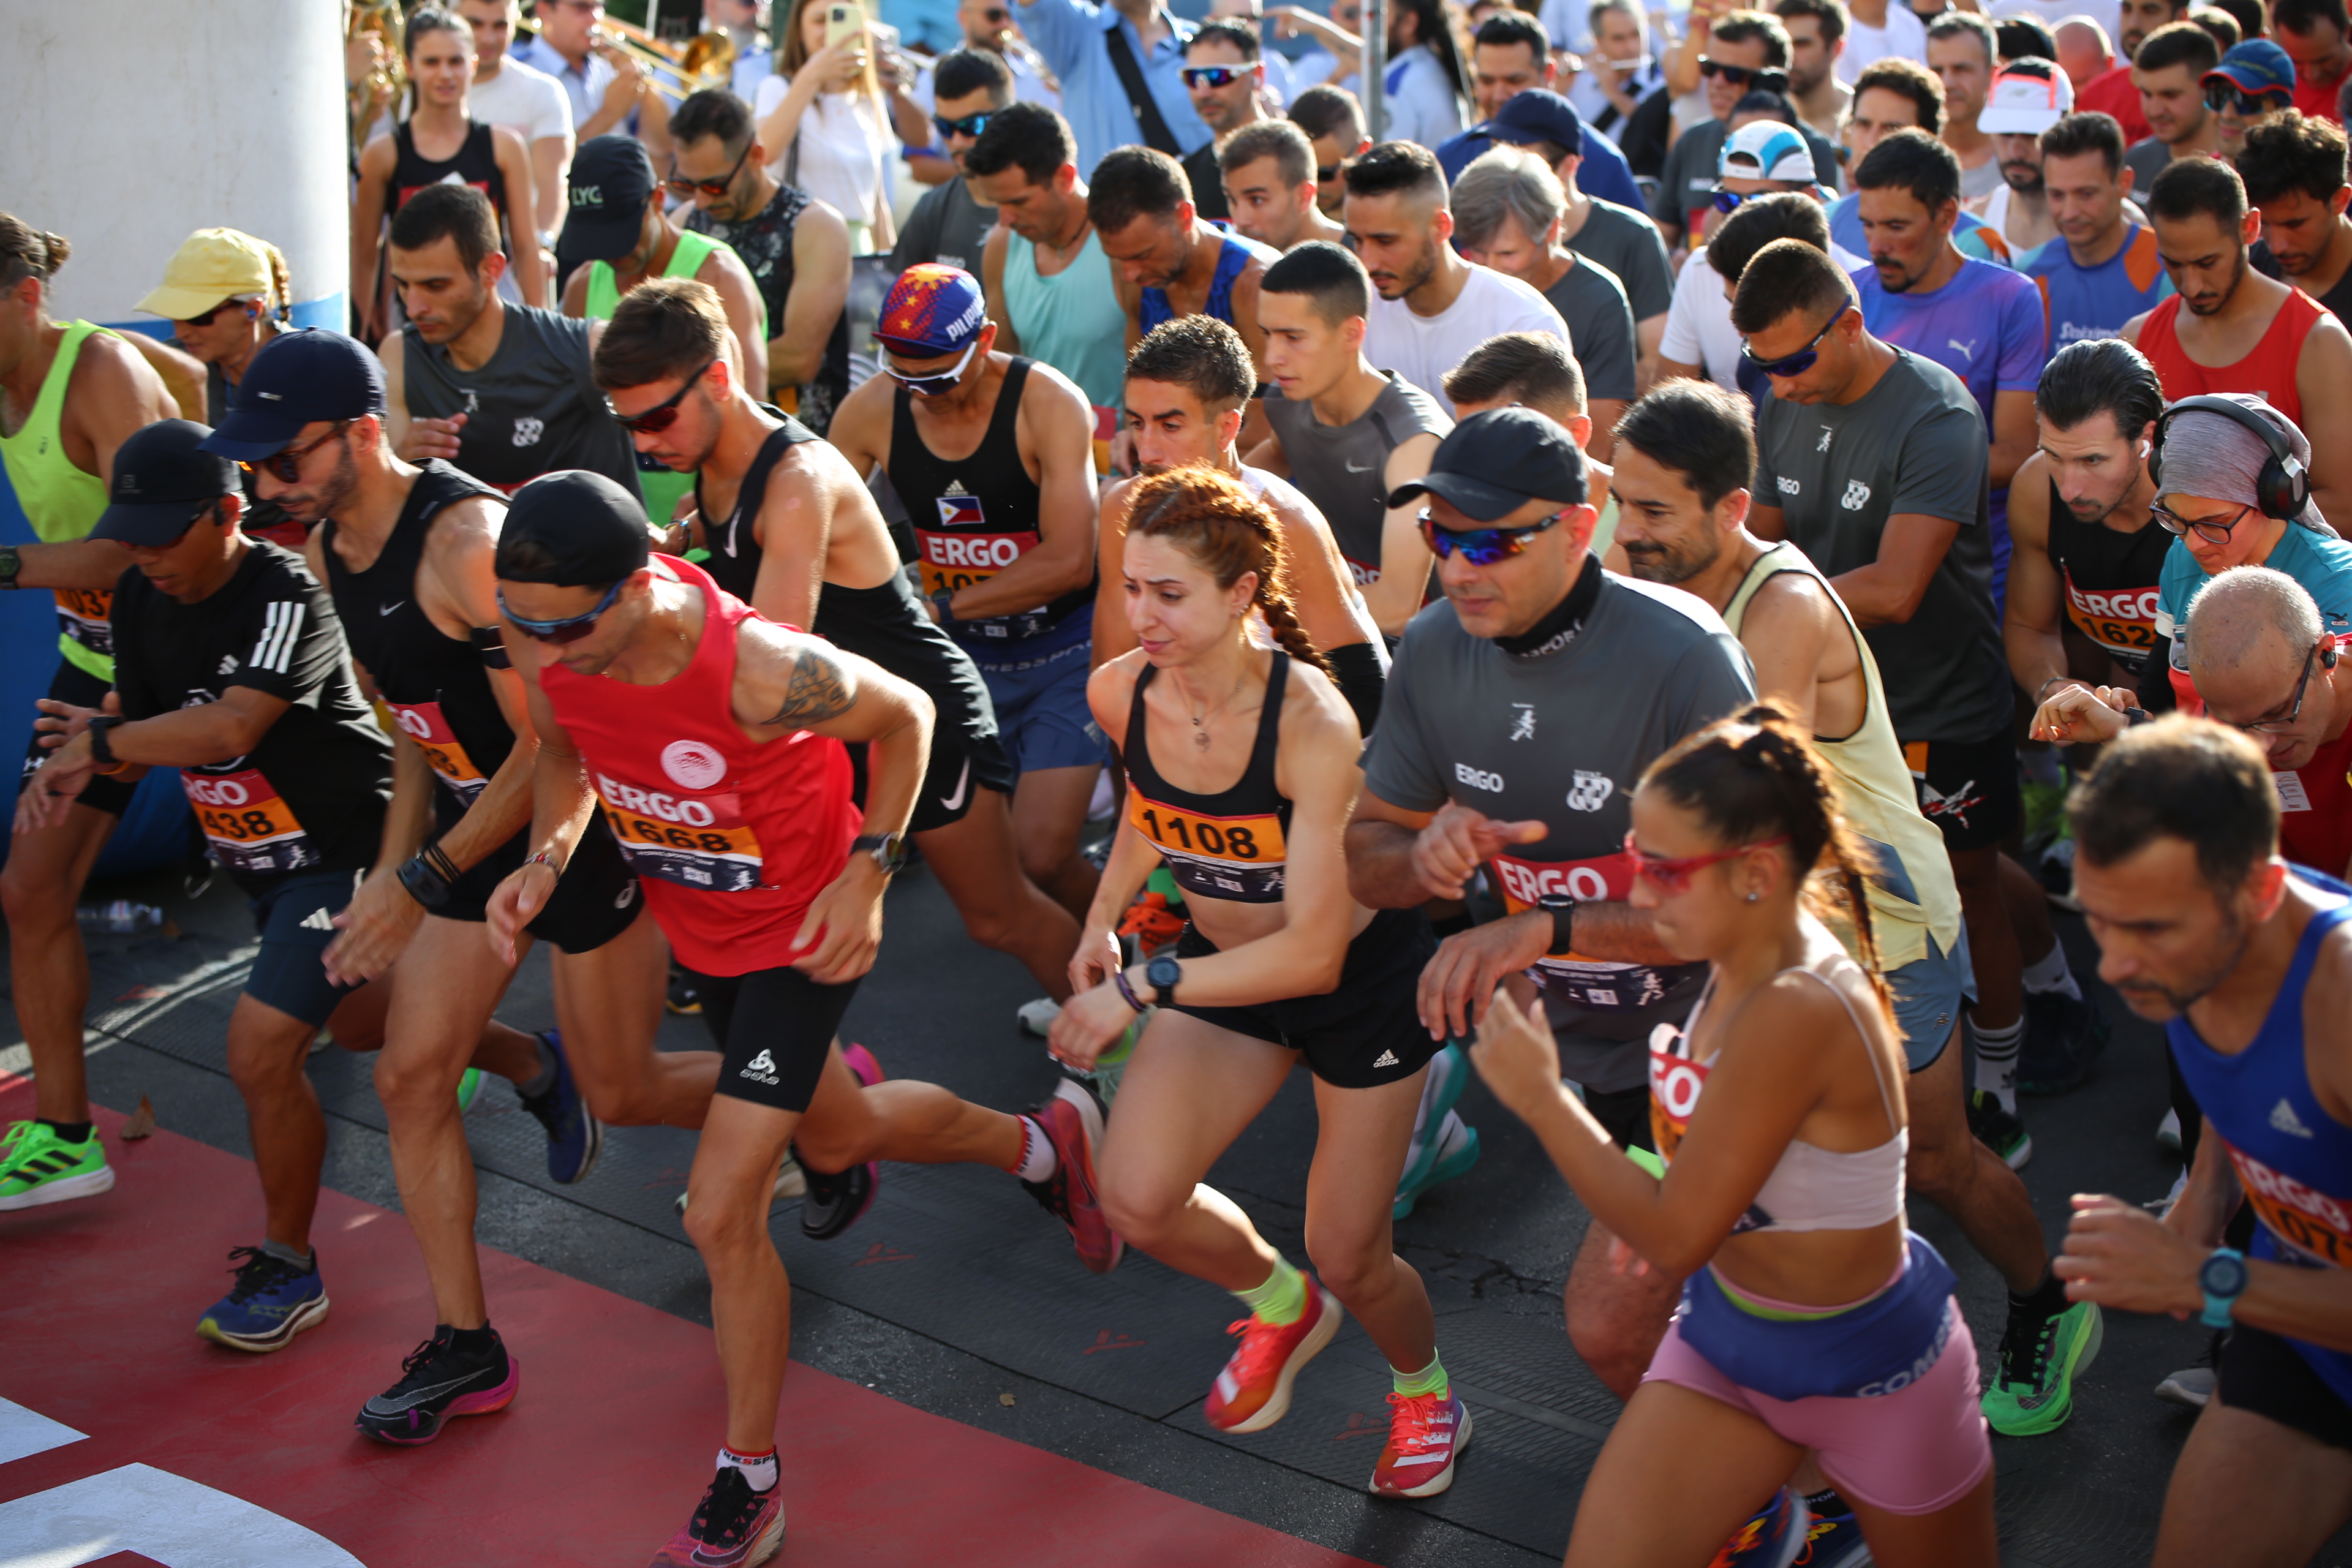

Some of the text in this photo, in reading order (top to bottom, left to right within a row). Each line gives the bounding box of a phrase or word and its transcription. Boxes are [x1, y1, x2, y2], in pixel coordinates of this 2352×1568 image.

[926, 536, 1019, 567] ERGO
[2070, 586, 2160, 619] ERGO
[2081, 616, 2157, 646] 162
[1455, 763, 1504, 793] ERGO
[597, 772, 715, 827] ERGO
[608, 811, 733, 852] 1668
[1142, 808, 1259, 859] 1108
[1496, 859, 1608, 903] ERGO
[1373, 1058, 1400, 1068] adidas
